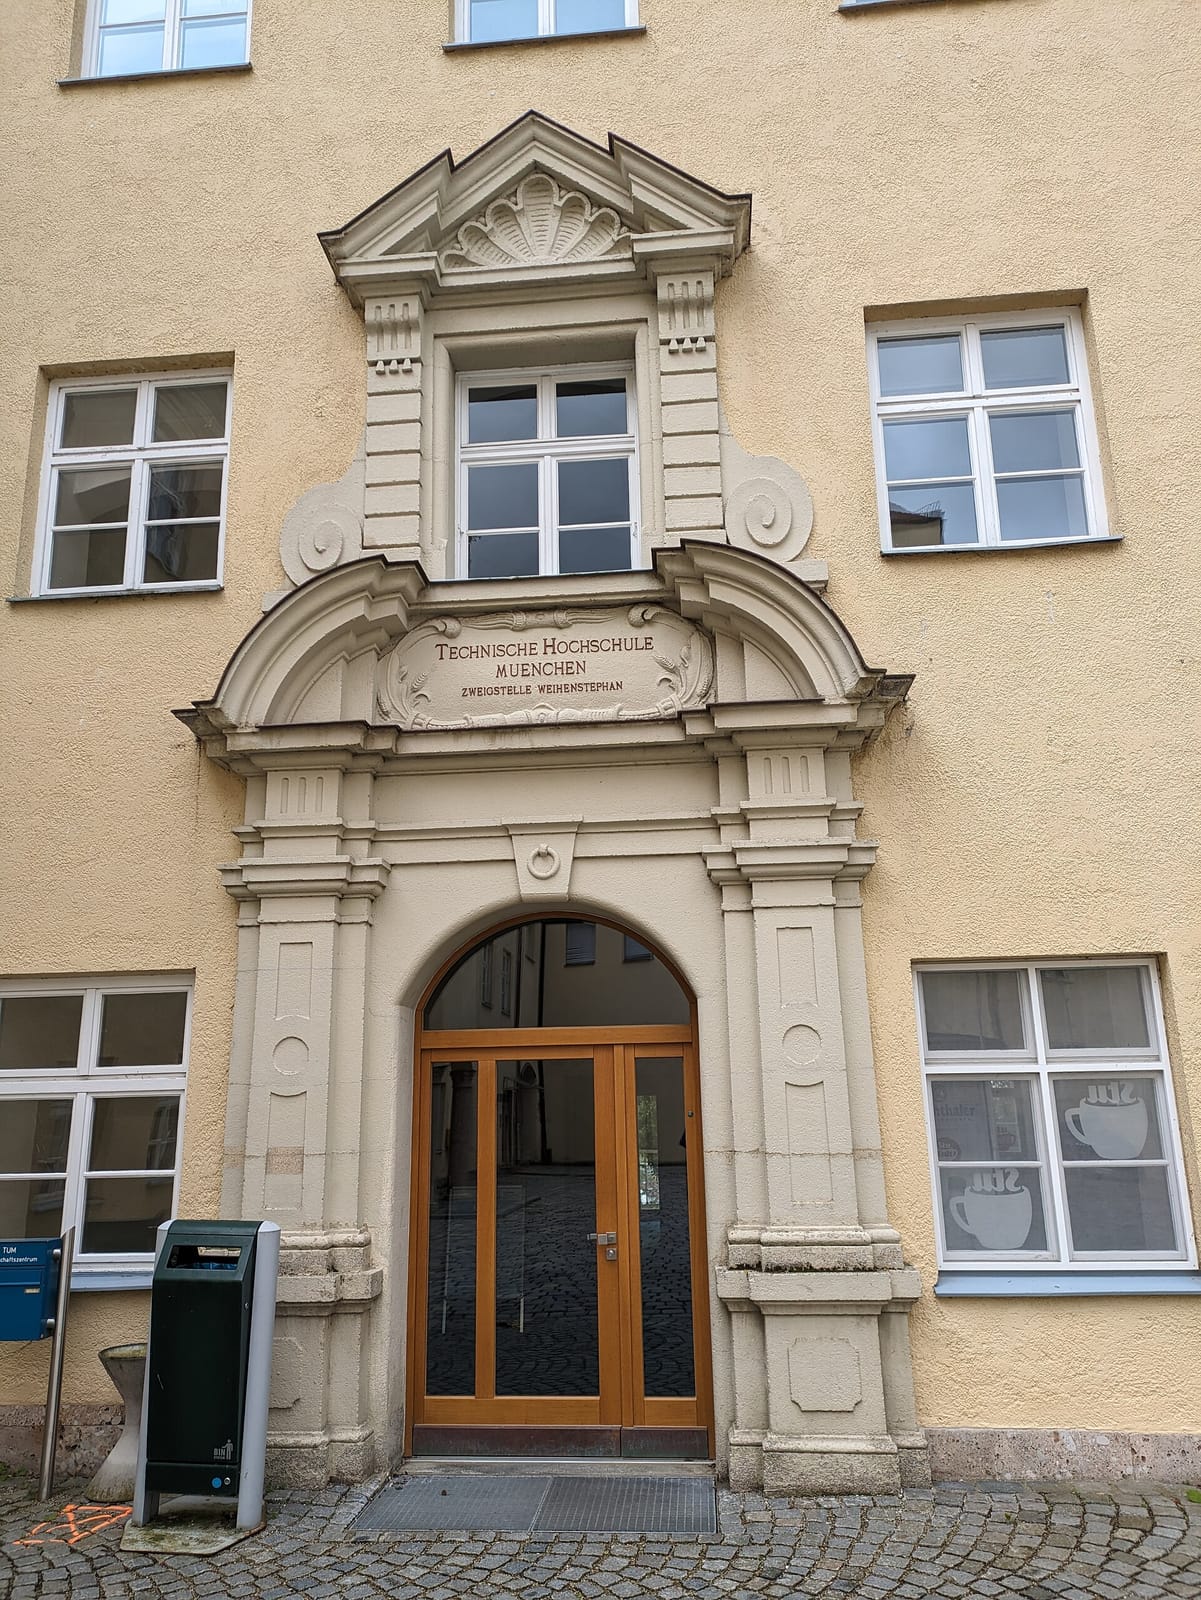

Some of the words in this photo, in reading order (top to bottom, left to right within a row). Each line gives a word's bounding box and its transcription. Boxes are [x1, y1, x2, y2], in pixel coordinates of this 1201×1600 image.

[435, 642, 539, 660] TECHNISCHE
[542, 637, 655, 655] HOCHSCHULE
[495, 660, 587, 678] MUENCHEN
[461, 685, 532, 697] ZWEIGSTELLE
[537, 681, 623, 695] WEIHENSTEPHAN
